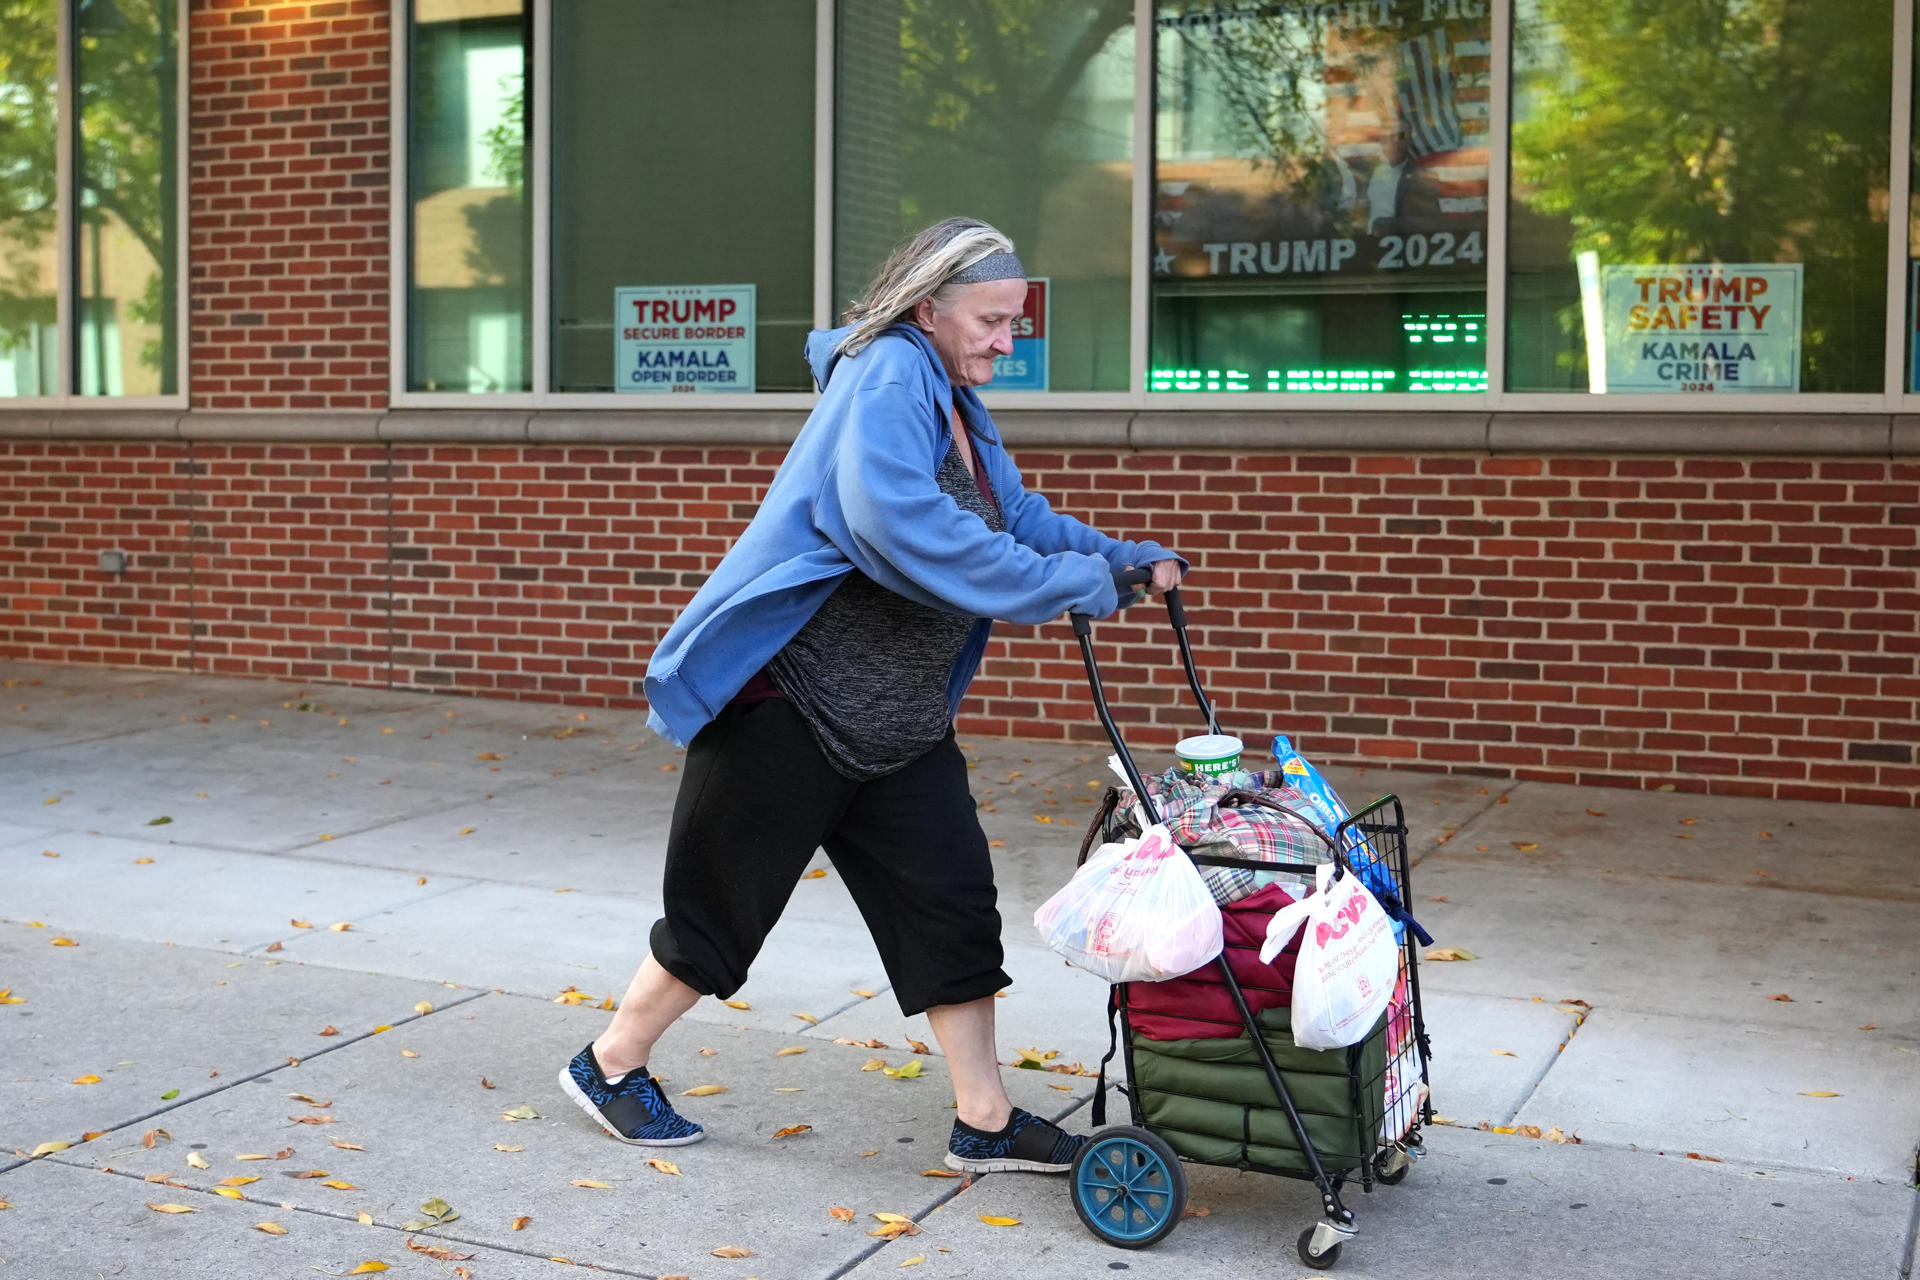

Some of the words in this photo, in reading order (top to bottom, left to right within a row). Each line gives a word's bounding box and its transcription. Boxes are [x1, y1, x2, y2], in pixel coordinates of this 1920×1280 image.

[1202, 238, 1356, 275] TRUMP
[1378, 231, 1483, 269] 2024
[1634, 276, 1768, 304] TRUMP
[632, 298, 737, 324] TRUMP
[1630, 305, 1772, 331] SAFETY
[623, 327, 680, 340] SECURE
[684, 326, 745, 340] BORDER
[638, 350, 730, 369] KAMALA
[1641, 342, 1756, 361] KAMALA
[631, 371, 671, 383] OPEN
[675, 370, 737, 383] BORDER
[1657, 362, 1739, 381] CRIME
[1681, 383, 1714, 392] 2024
[1194, 758, 1237, 772] HERE'S
[1310, 793, 1336, 822] OREO
